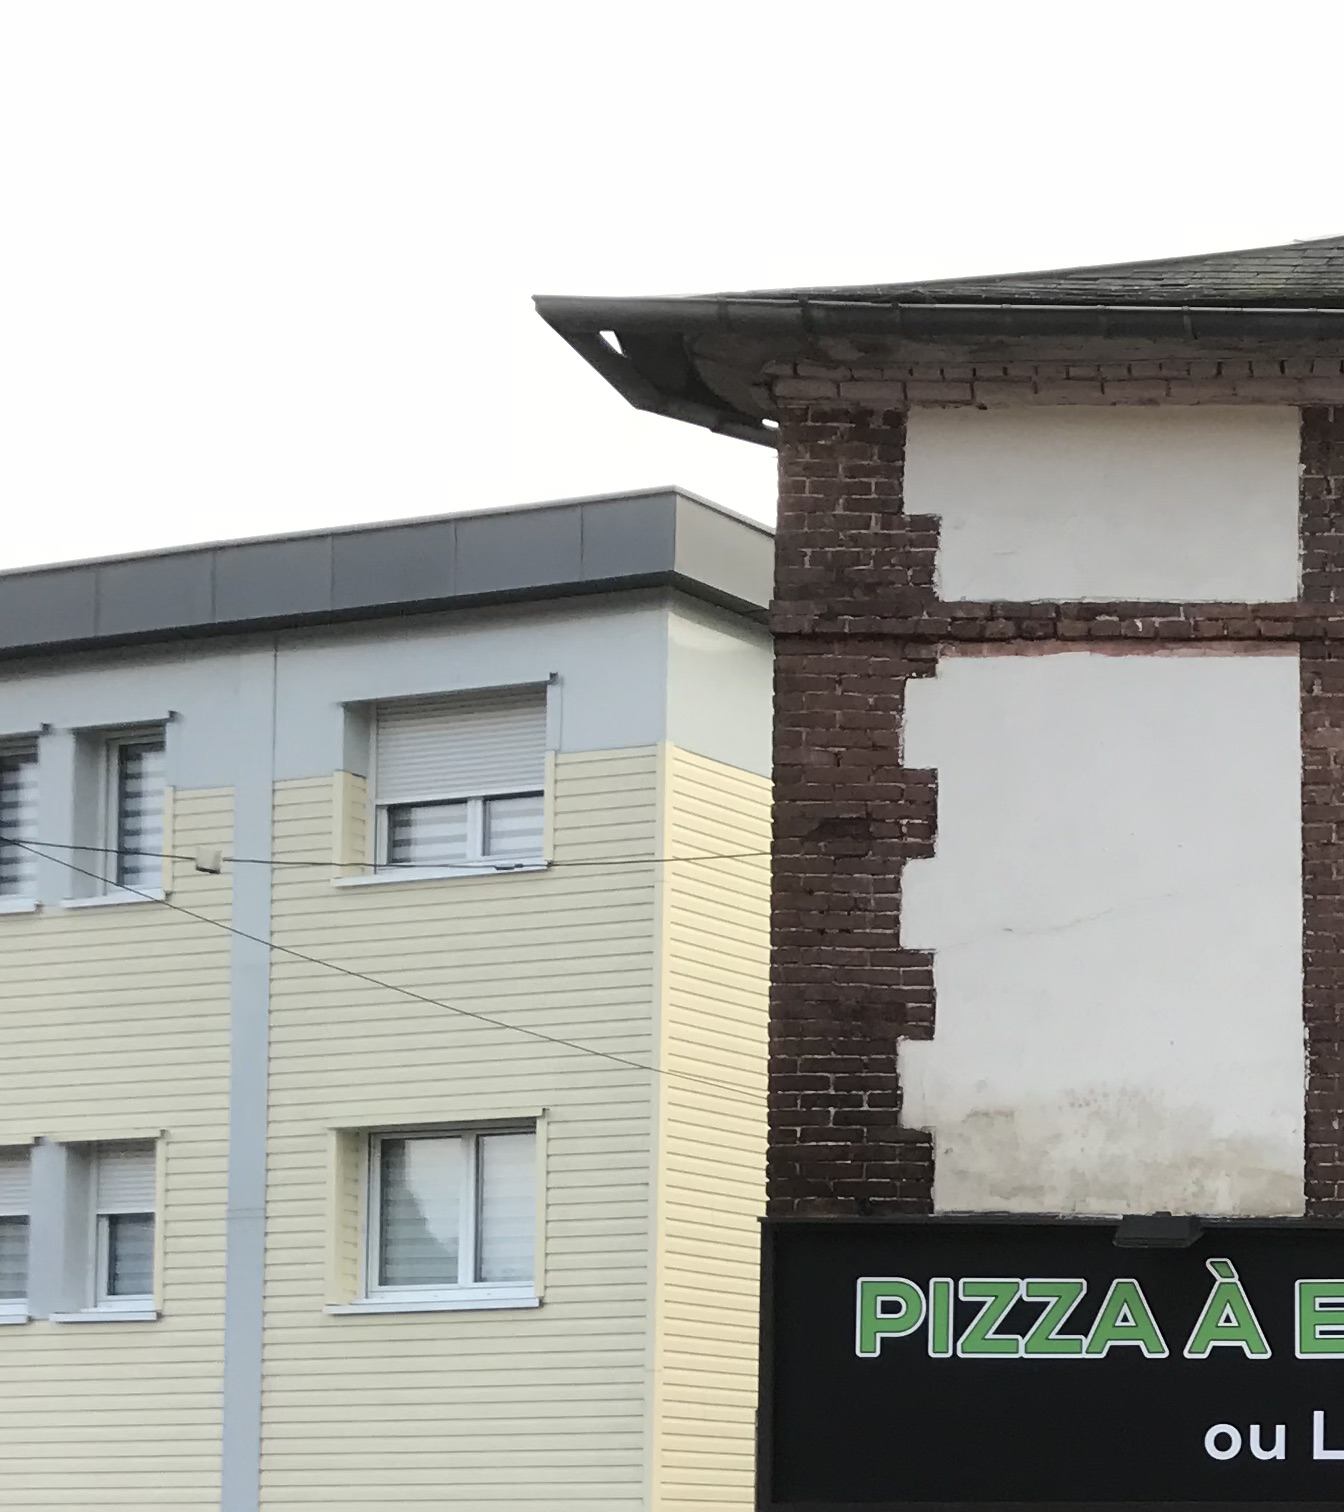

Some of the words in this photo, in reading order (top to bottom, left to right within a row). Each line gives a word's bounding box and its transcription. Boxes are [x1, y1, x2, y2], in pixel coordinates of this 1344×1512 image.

[855, 1277, 1169, 1359] PIZZA
[1183, 1258, 1271, 1359] À
[1204, 1422, 1286, 1461] ou
